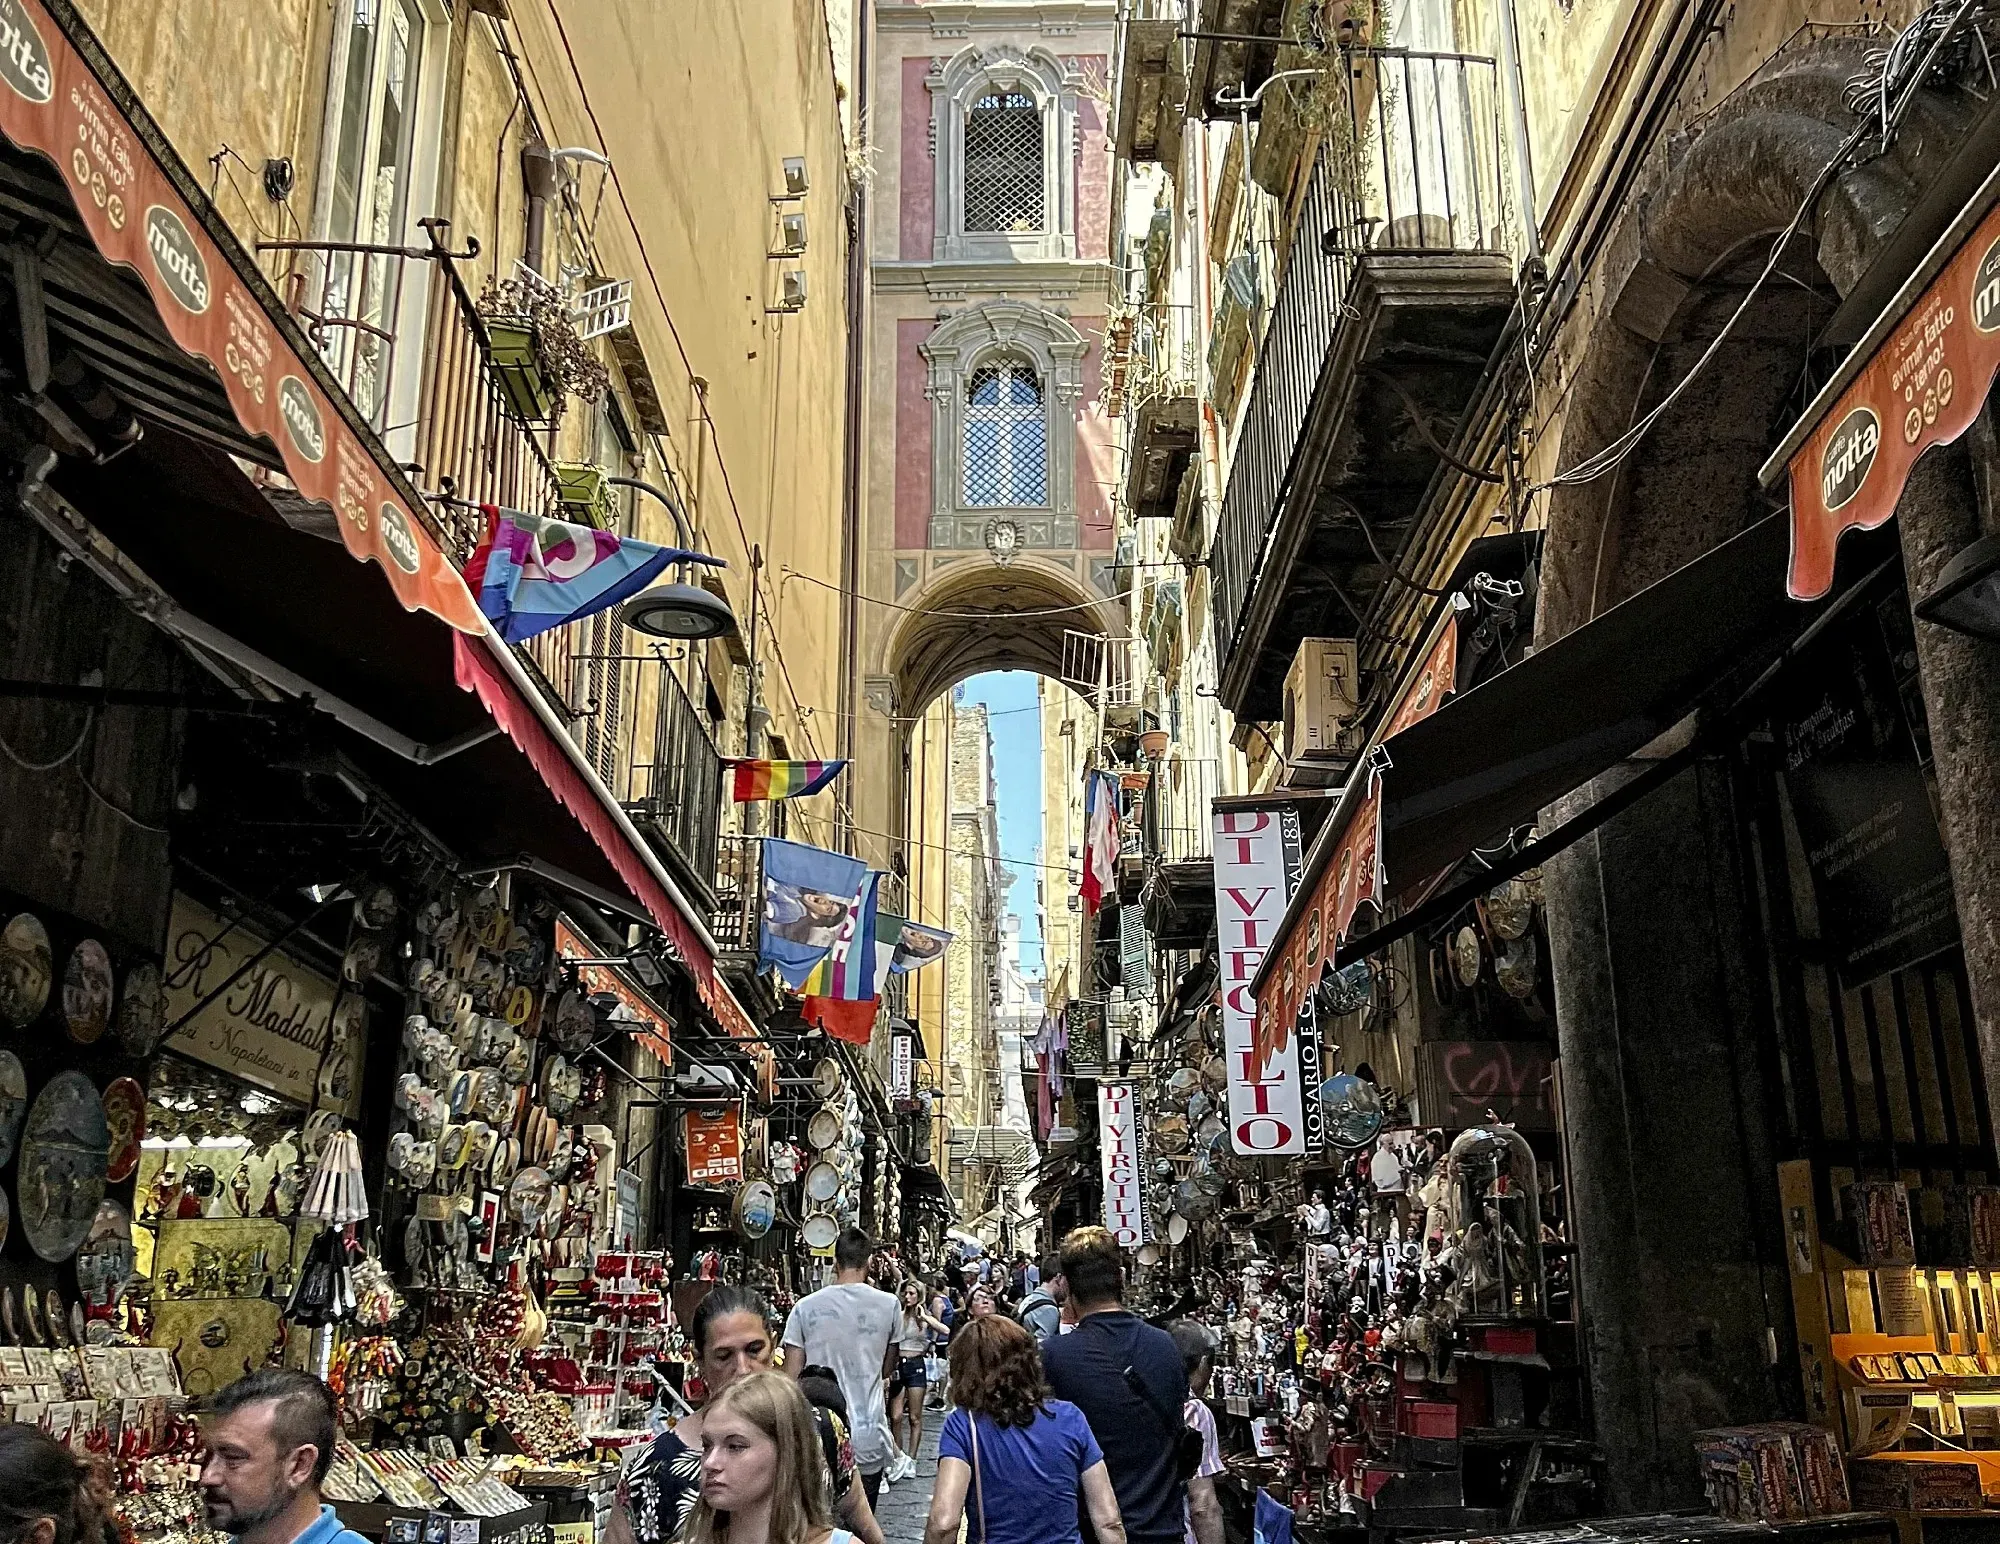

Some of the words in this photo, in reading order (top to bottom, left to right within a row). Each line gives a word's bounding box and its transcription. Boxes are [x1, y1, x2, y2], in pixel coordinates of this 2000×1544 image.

[0, 14, 51, 98] otta
[149, 222, 208, 309] motta
[1892, 340, 1925, 392] avimm
[1924, 307, 1955, 348] fatto
[1823, 423, 1879, 505] motta
[1216, 812, 1270, 865] DI
[209, 1018, 287, 1075] Napoletani
[1103, 1085, 1129, 1115] DI
[1302, 1046, 1323, 1147] ROSARIO
[1106, 1124, 1138, 1244] VIRGILIO
